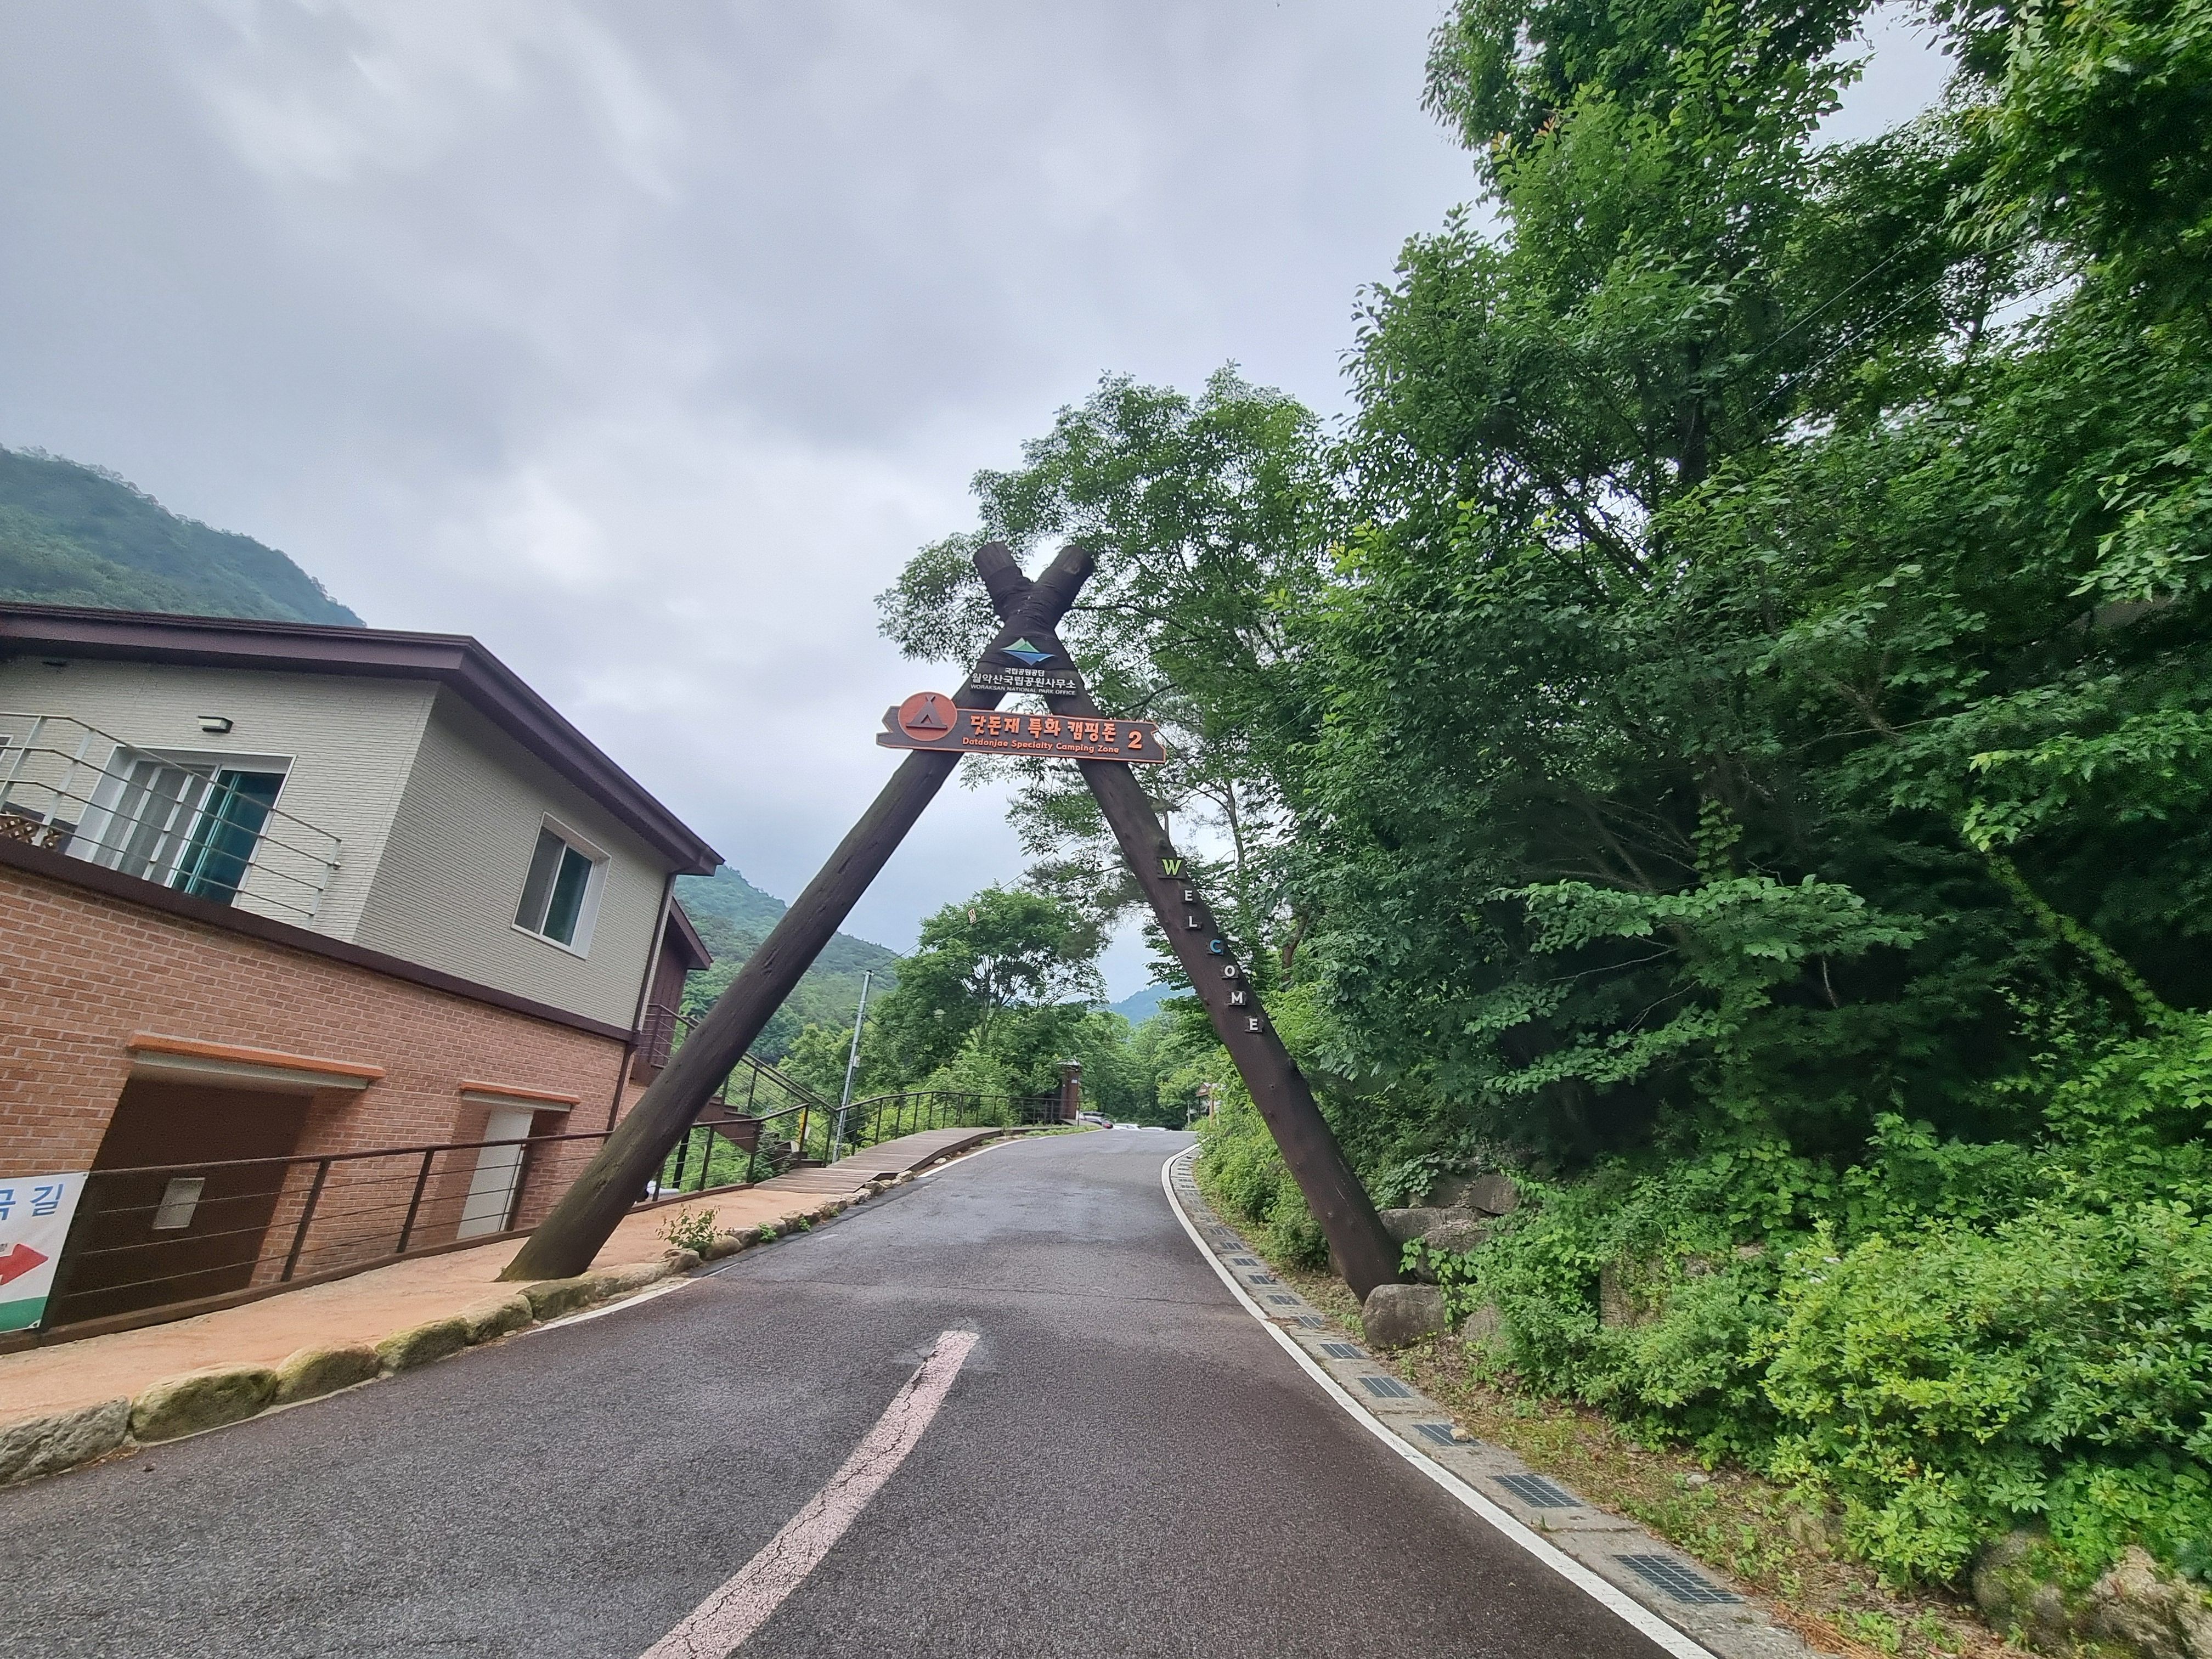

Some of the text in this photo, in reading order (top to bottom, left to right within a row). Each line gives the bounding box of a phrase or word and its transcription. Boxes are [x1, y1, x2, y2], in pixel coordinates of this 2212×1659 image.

[1005, 667, 1045, 677] 국립공원공단
[971, 673, 1076, 689] 월악산국립공원사무소
[970, 715, 1143, 749] 닷돈재 특화 캠핑존 2
[962, 737, 1120, 754] Datdonjae Specialty Camping Zone
